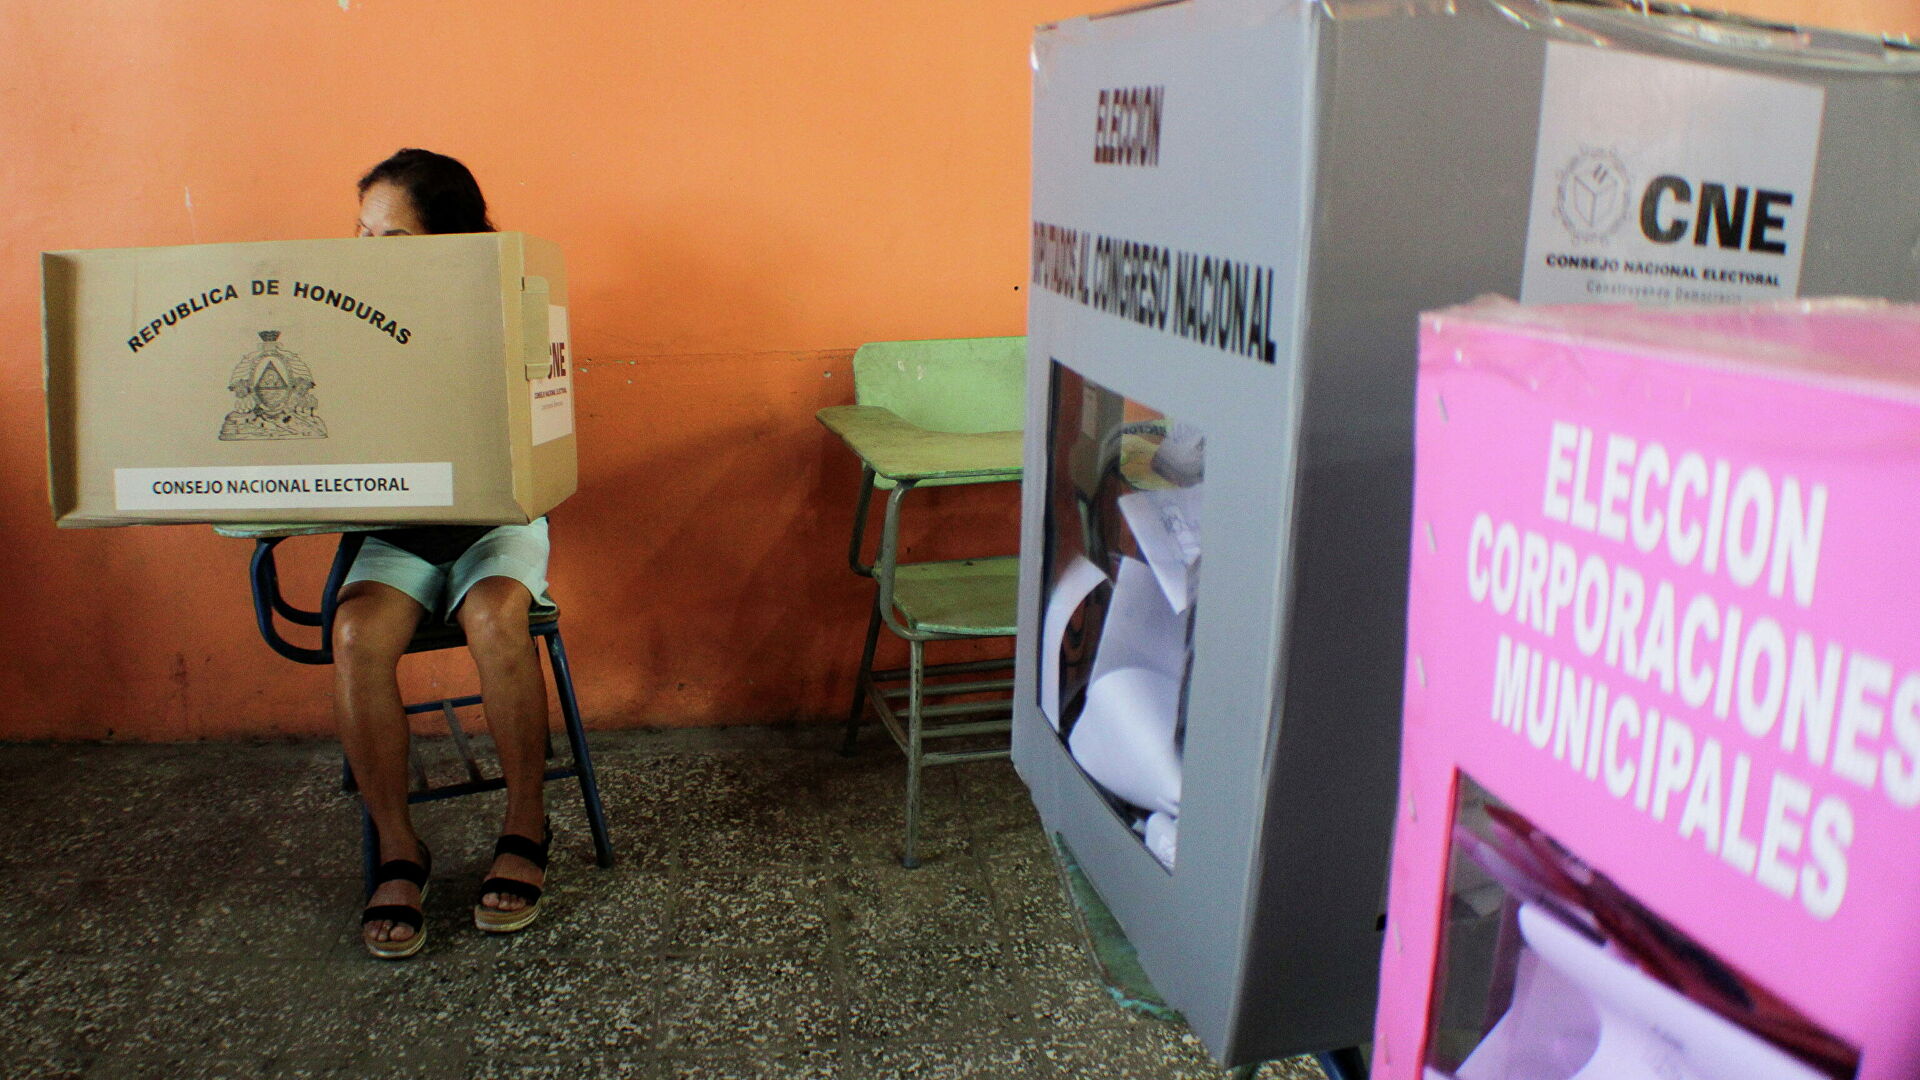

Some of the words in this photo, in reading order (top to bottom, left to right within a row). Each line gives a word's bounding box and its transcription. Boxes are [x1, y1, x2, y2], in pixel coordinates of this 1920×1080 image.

[1095, 85, 1165, 167] ELECCION
[1639, 173, 1794, 255] CNE
[1078, 230, 1091, 306] AL
[1094, 233, 1170, 332] CONGRESO
[1173, 249, 1277, 365] NACIONAL
[1545, 253, 1620, 273] CONSEJO
[1623, 261, 1698, 281] NACIONAL
[1702, 268, 1781, 287] ELECTORAL
[126, 284, 239, 354] REPUBLICA
[251, 279, 280, 296] DE
[292, 281, 412, 347] HONDURAS
[152, 479, 223, 495] CONSEJO
[226, 478, 311, 494] NACIONAL
[314, 476, 410, 493] ELECTORAL
[1542, 419, 1828, 609] ELECCION
[1466, 511, 1920, 810] CORPORACIONES
[1490, 633, 1855, 922] MUNICIPALES
